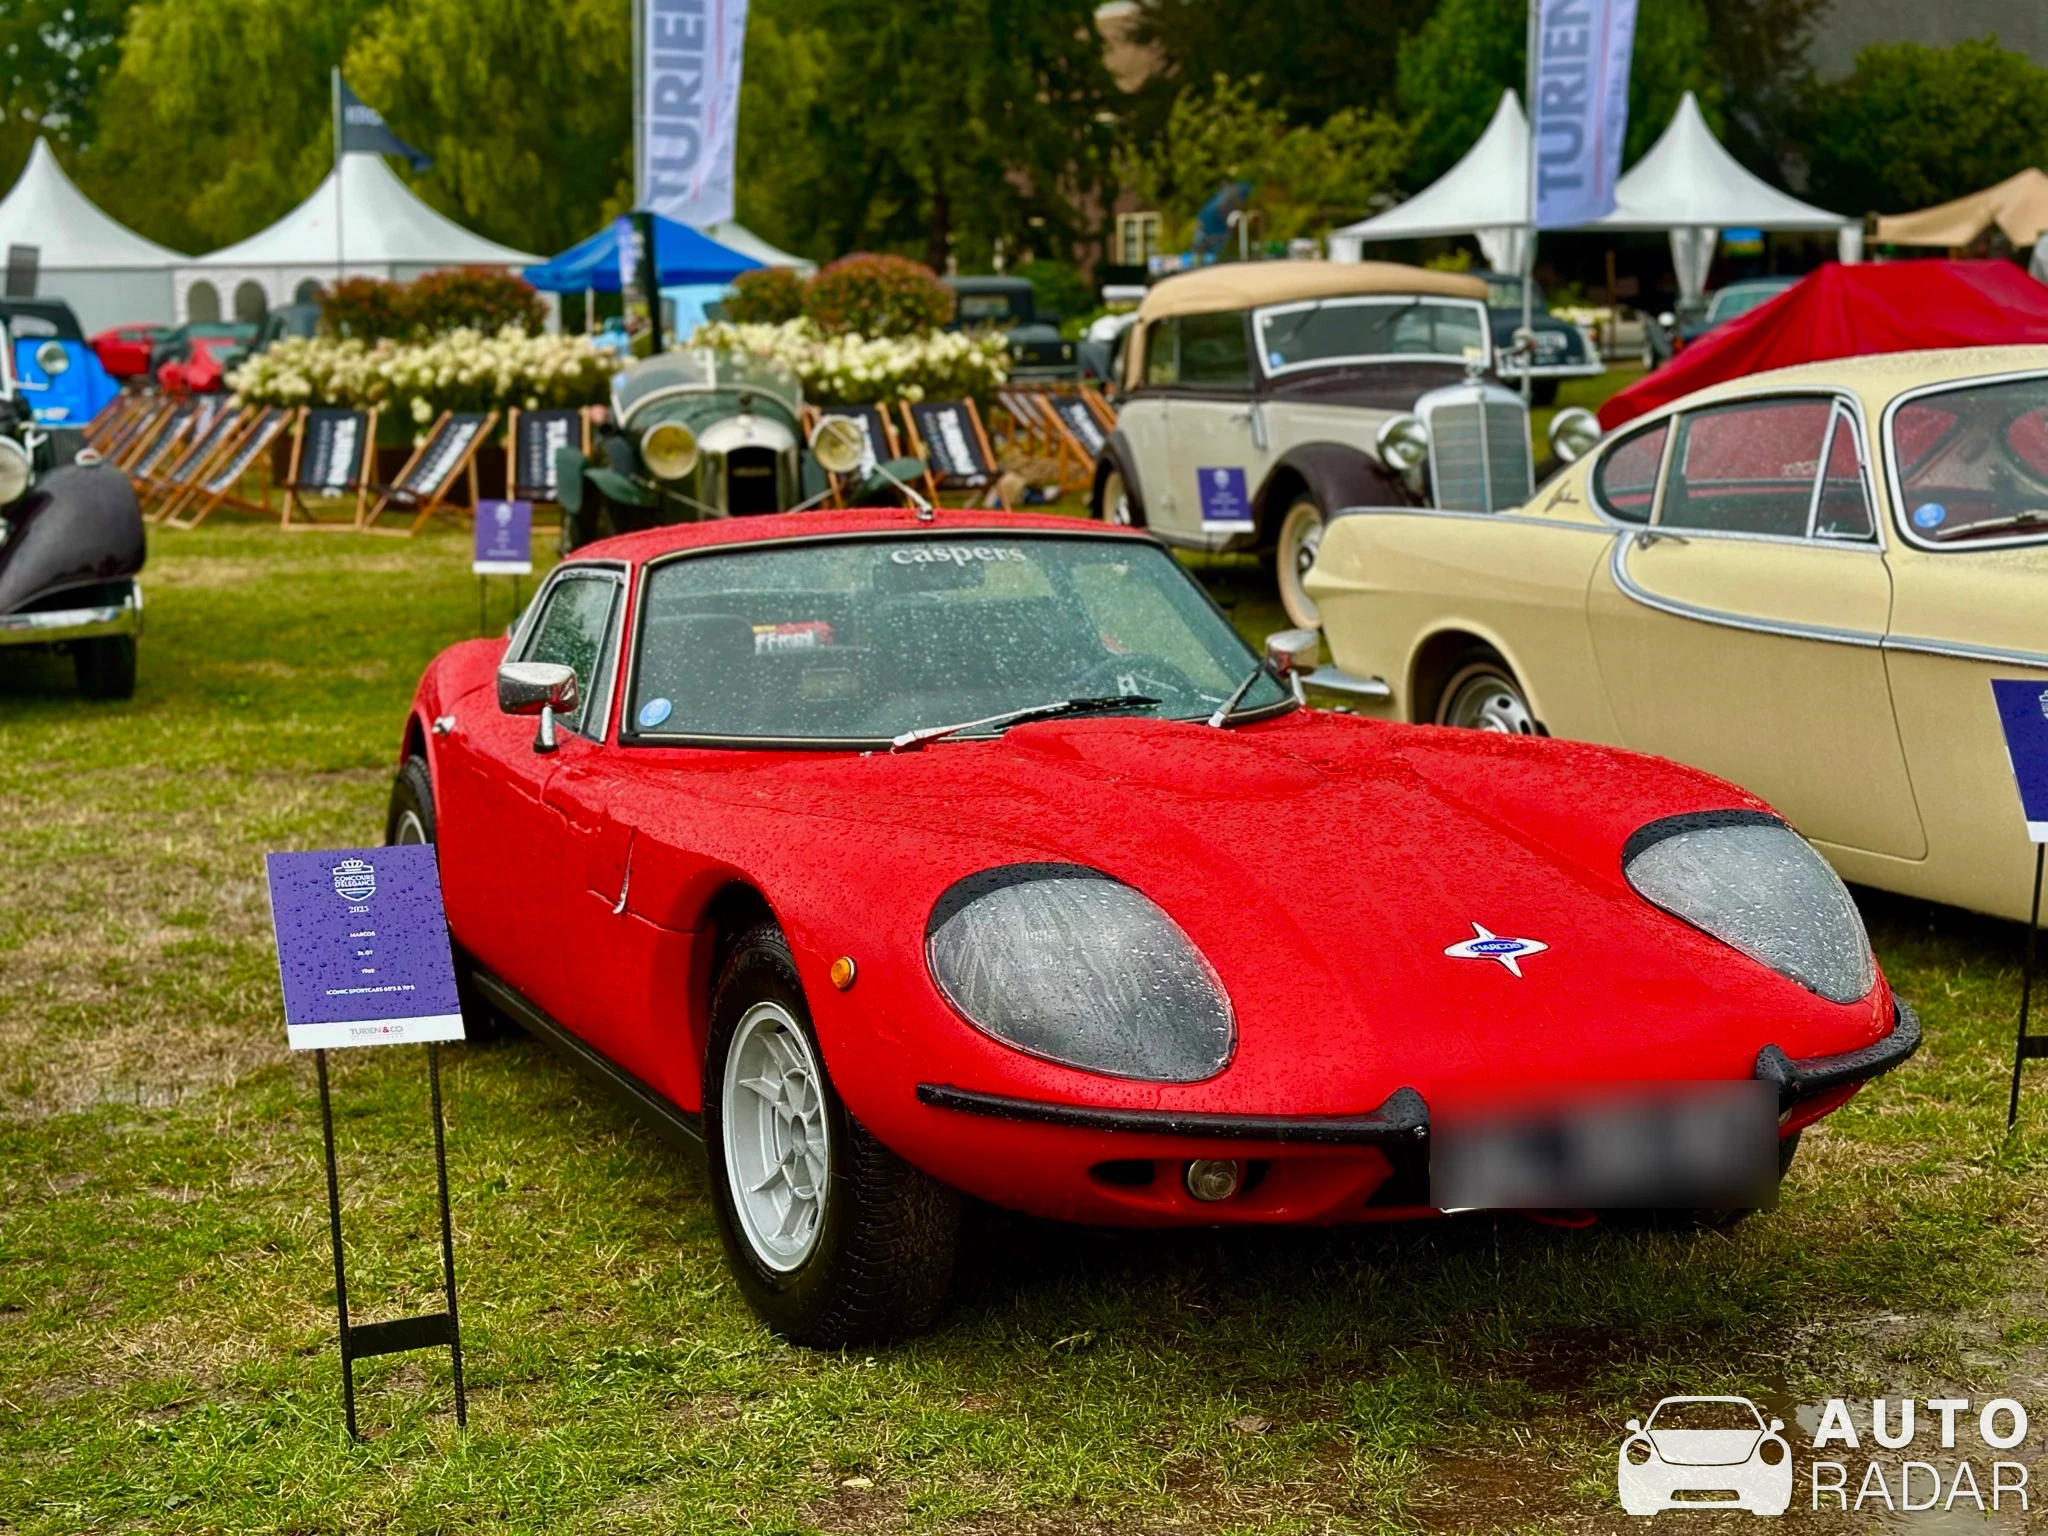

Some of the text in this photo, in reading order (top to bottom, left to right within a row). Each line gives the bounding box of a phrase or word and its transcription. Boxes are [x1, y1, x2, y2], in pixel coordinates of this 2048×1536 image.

[649, 0, 706, 203] TURIE
[890, 546, 1027, 568] caspers
[334, 874, 375, 882] CONCOURS
